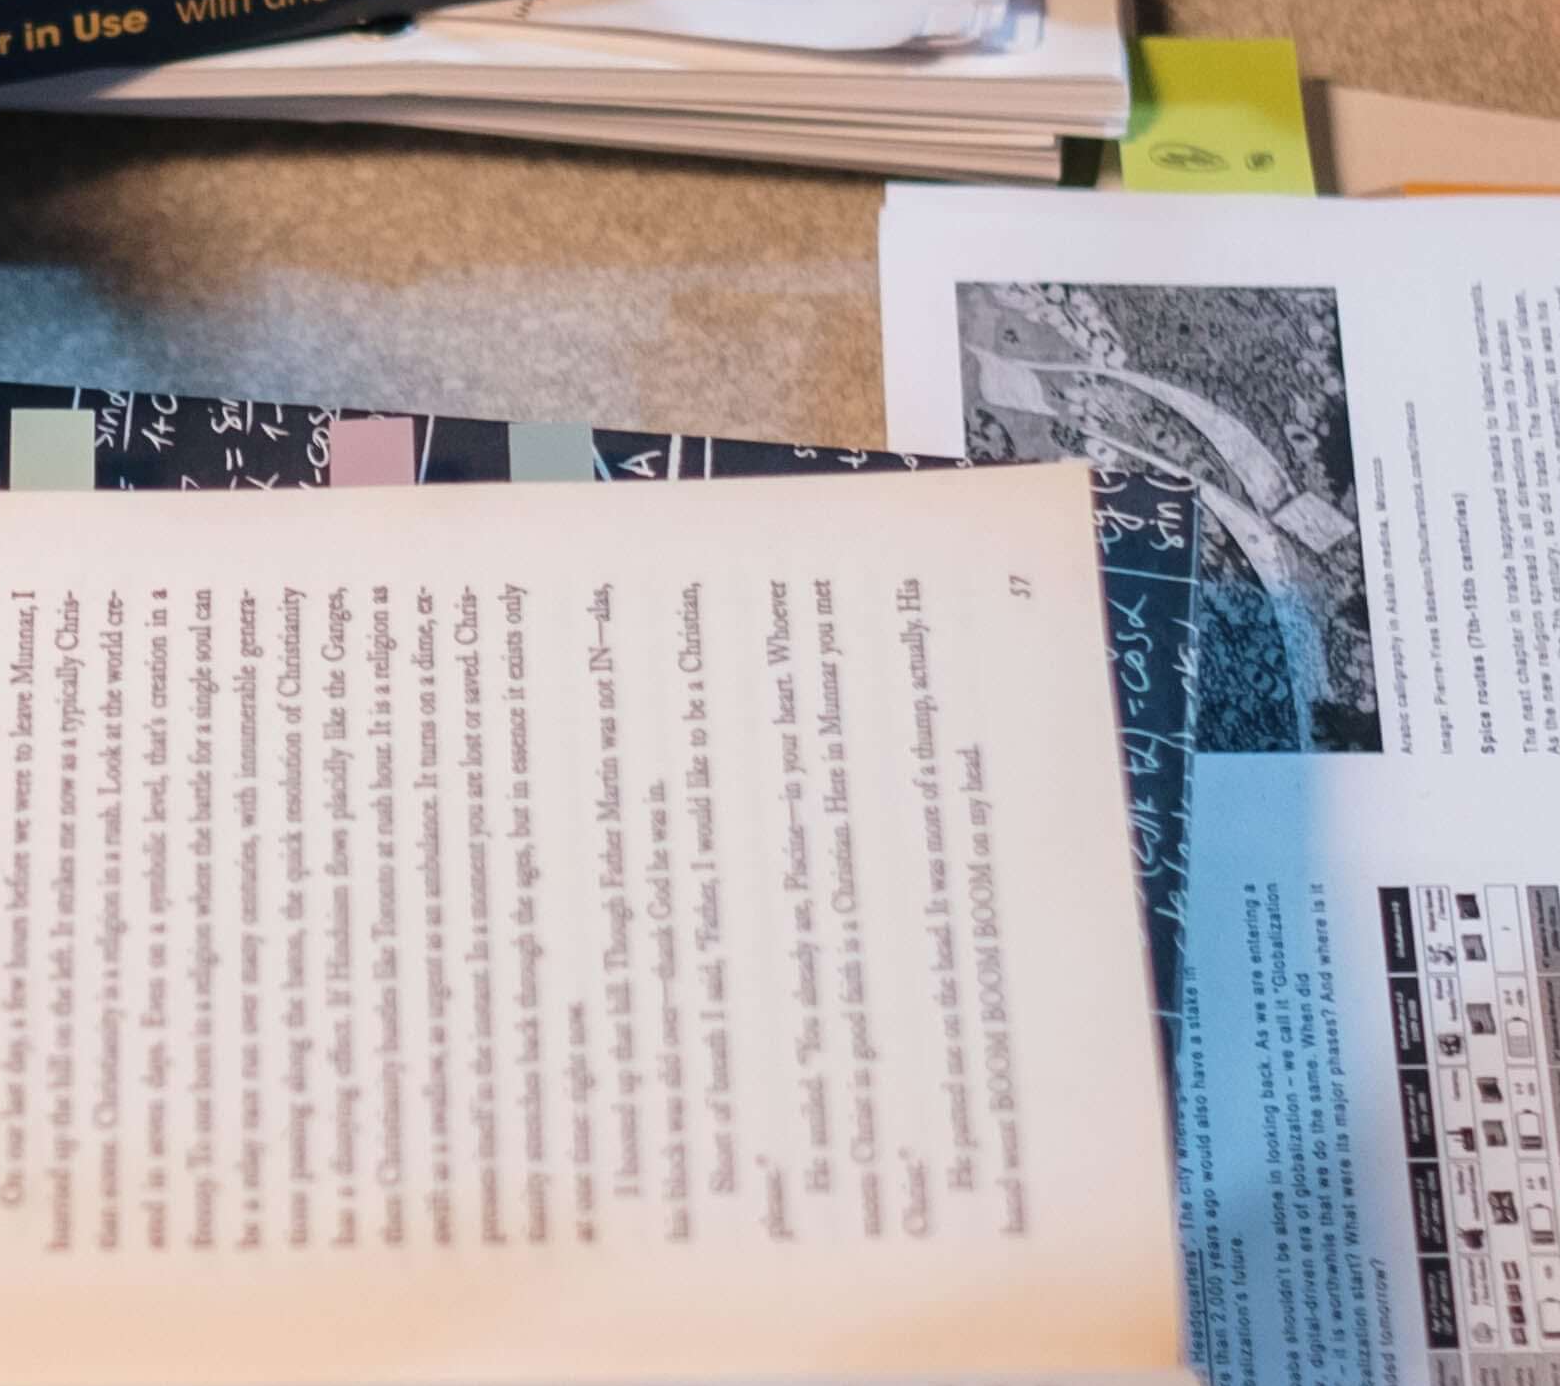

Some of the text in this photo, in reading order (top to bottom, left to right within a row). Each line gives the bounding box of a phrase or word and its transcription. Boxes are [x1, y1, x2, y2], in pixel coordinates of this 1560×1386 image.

[23, 20, 62, 52] in
[72, 6, 150, 42] Use
[1453, 492, 1497, 755] Spice routes (7th-15th centuries)
[1243, 883, 1257, 894] a
[1307, 882, 1324, 895] it
[1309, 898, 1326, 913] is
[1244, 898, 1263, 965] entering
[1314, 917, 1332, 966] where
[1251, 969, 1265, 996] are
[1316, 970, 1335, 1004] And
[1254, 1001, 1267, 1024] we
[1253, 1028, 1270, 1051] As
[1319, 1007, 1346, 1076] phases?
[1329, 1080, 1349, 1127] major
[1262, 1104, 1282, 1164] looking
[1334, 1132, 1351, 1153] its
[1266, 1168, 1283, 1185] in
[1338, 1158, 1355, 1198] were
[1271, 1190, 1289, 1236] alone
[1340, 1203, 1359, 1247] What
[1274, 1241, 1291, 1262] be
[1343, 1252, 1366, 1301] start?
[1275, 1267, 1299, 1345] shouldn't
[1367, 1256, 1394, 1347] tomorrow?
